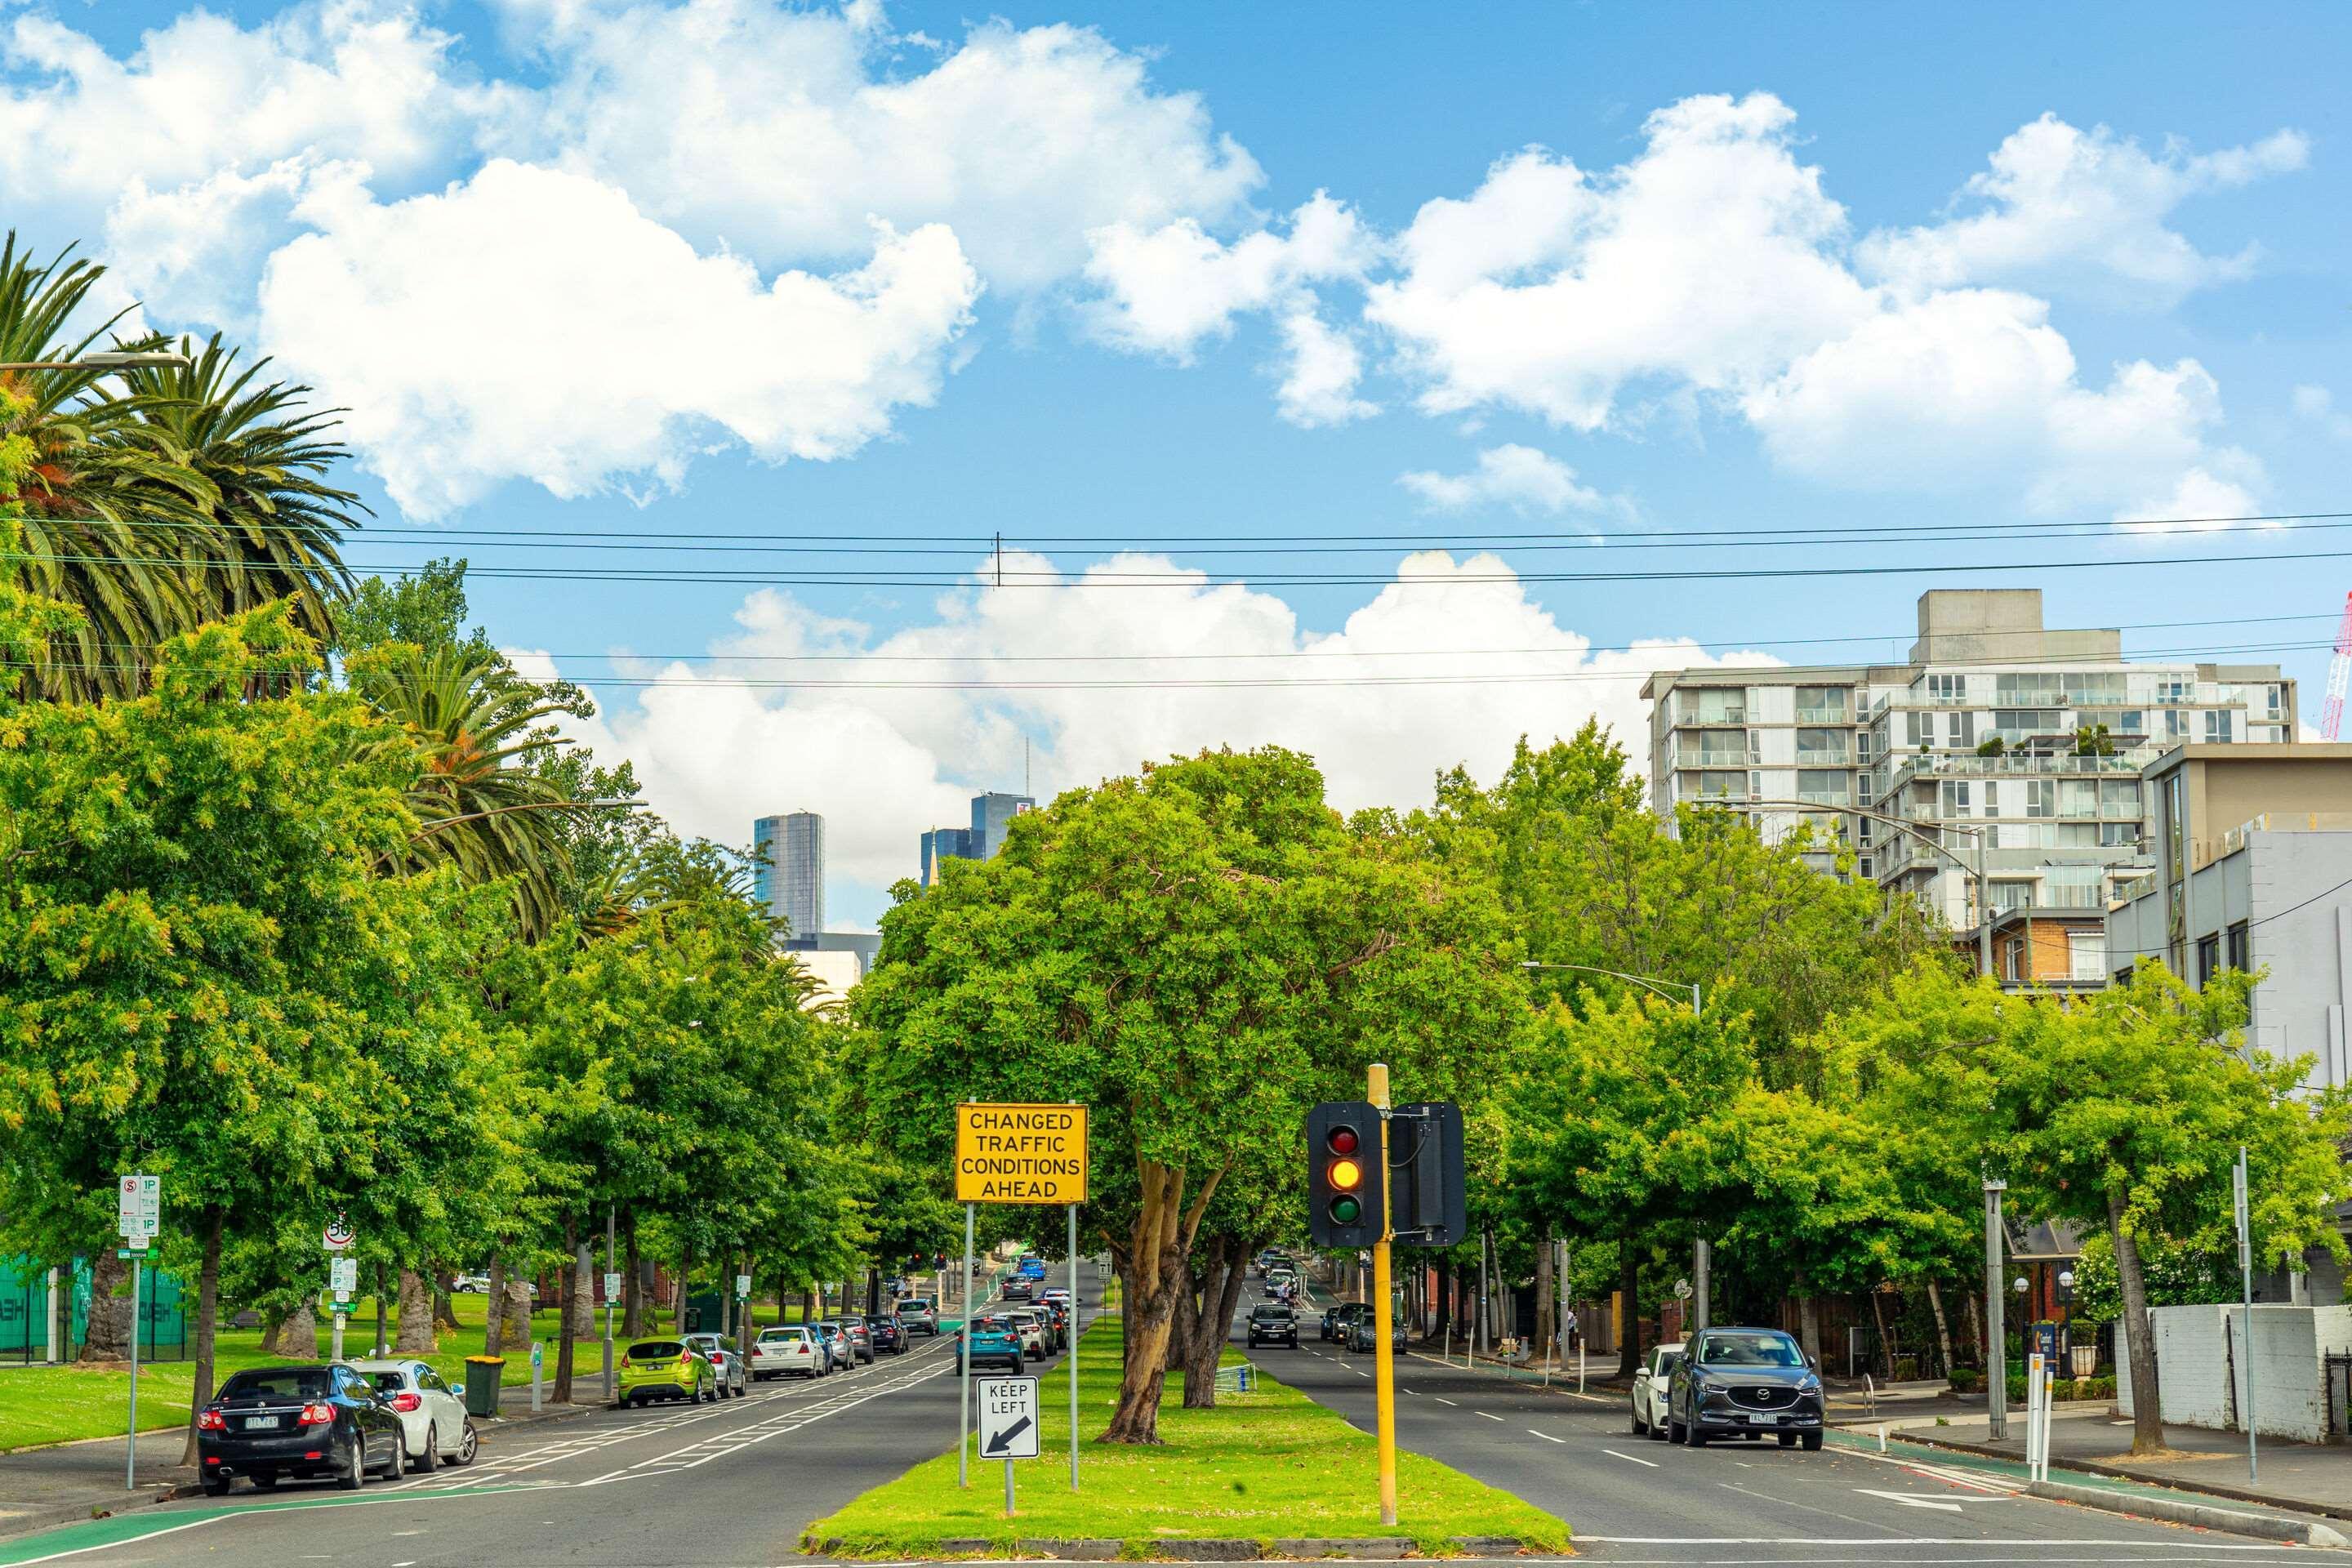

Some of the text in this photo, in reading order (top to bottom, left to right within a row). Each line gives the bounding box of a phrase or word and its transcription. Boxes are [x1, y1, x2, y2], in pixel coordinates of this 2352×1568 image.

[970, 1113, 1072, 1129] CHANGED
[975, 1135, 1065, 1152] TRAFFIC
[961, 1158, 1080, 1175] CONDITIONS
[144, 1180, 156, 1189] 1P
[982, 1181, 1057, 1197] AHEAD
[143, 1220, 155, 1229] 1P
[990, 1385, 1027, 1397] KEEP
[991, 1401, 1027, 1414] LEFT
